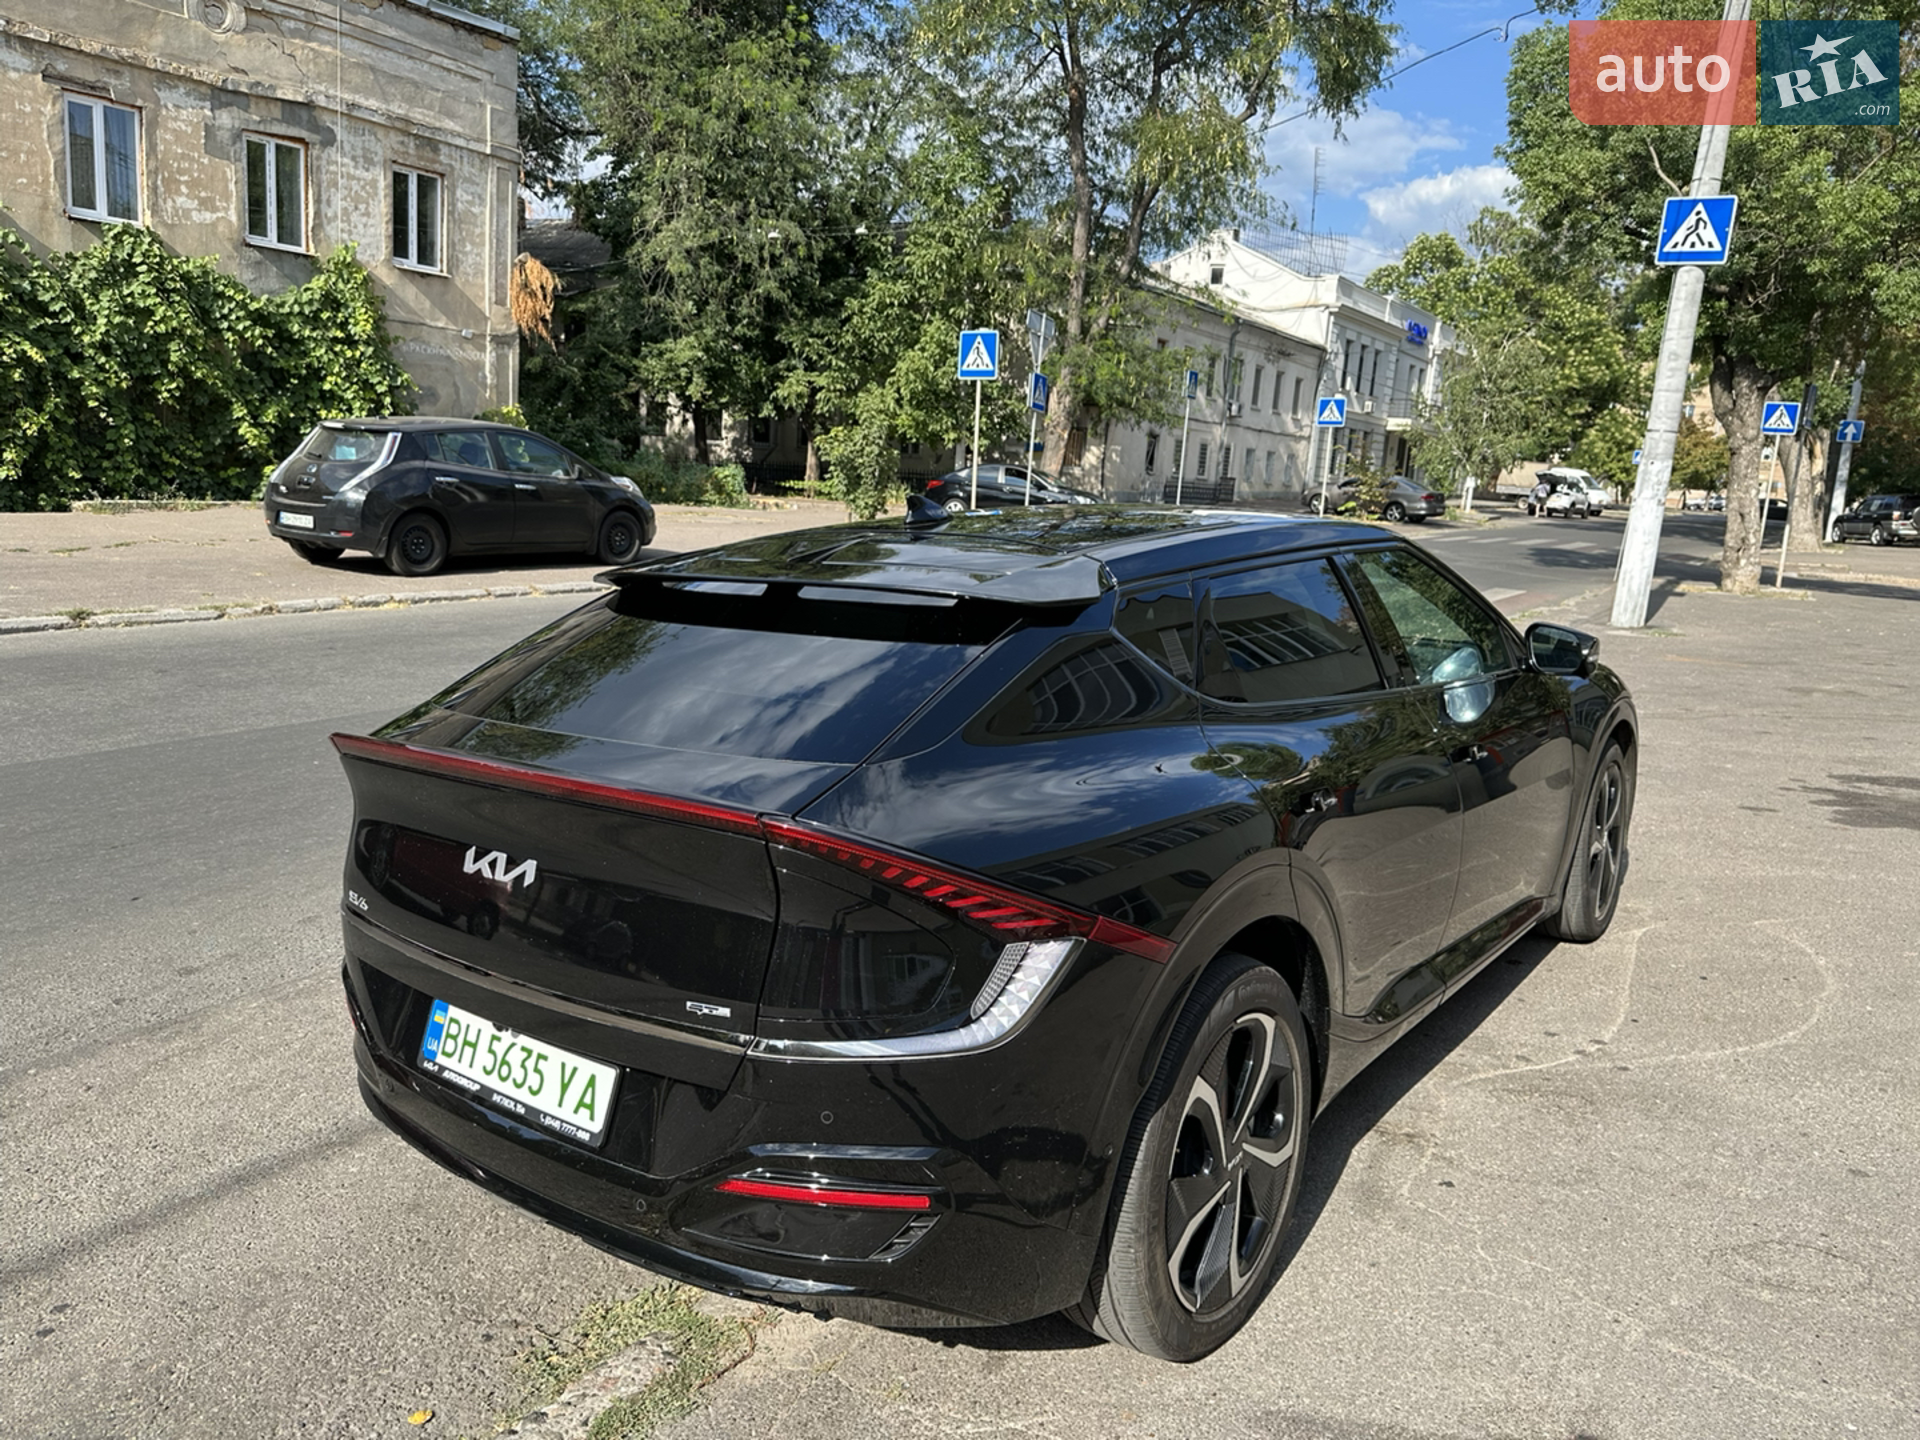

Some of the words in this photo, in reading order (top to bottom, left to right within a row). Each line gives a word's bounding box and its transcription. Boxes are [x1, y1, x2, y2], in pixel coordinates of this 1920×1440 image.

[463, 845, 538, 888] KIA
[427, 1036, 439, 1052] UA
[441, 1016, 482, 1069] BH
[482, 1034, 548, 1097] 5635
[558, 1061, 597, 1122] YA
